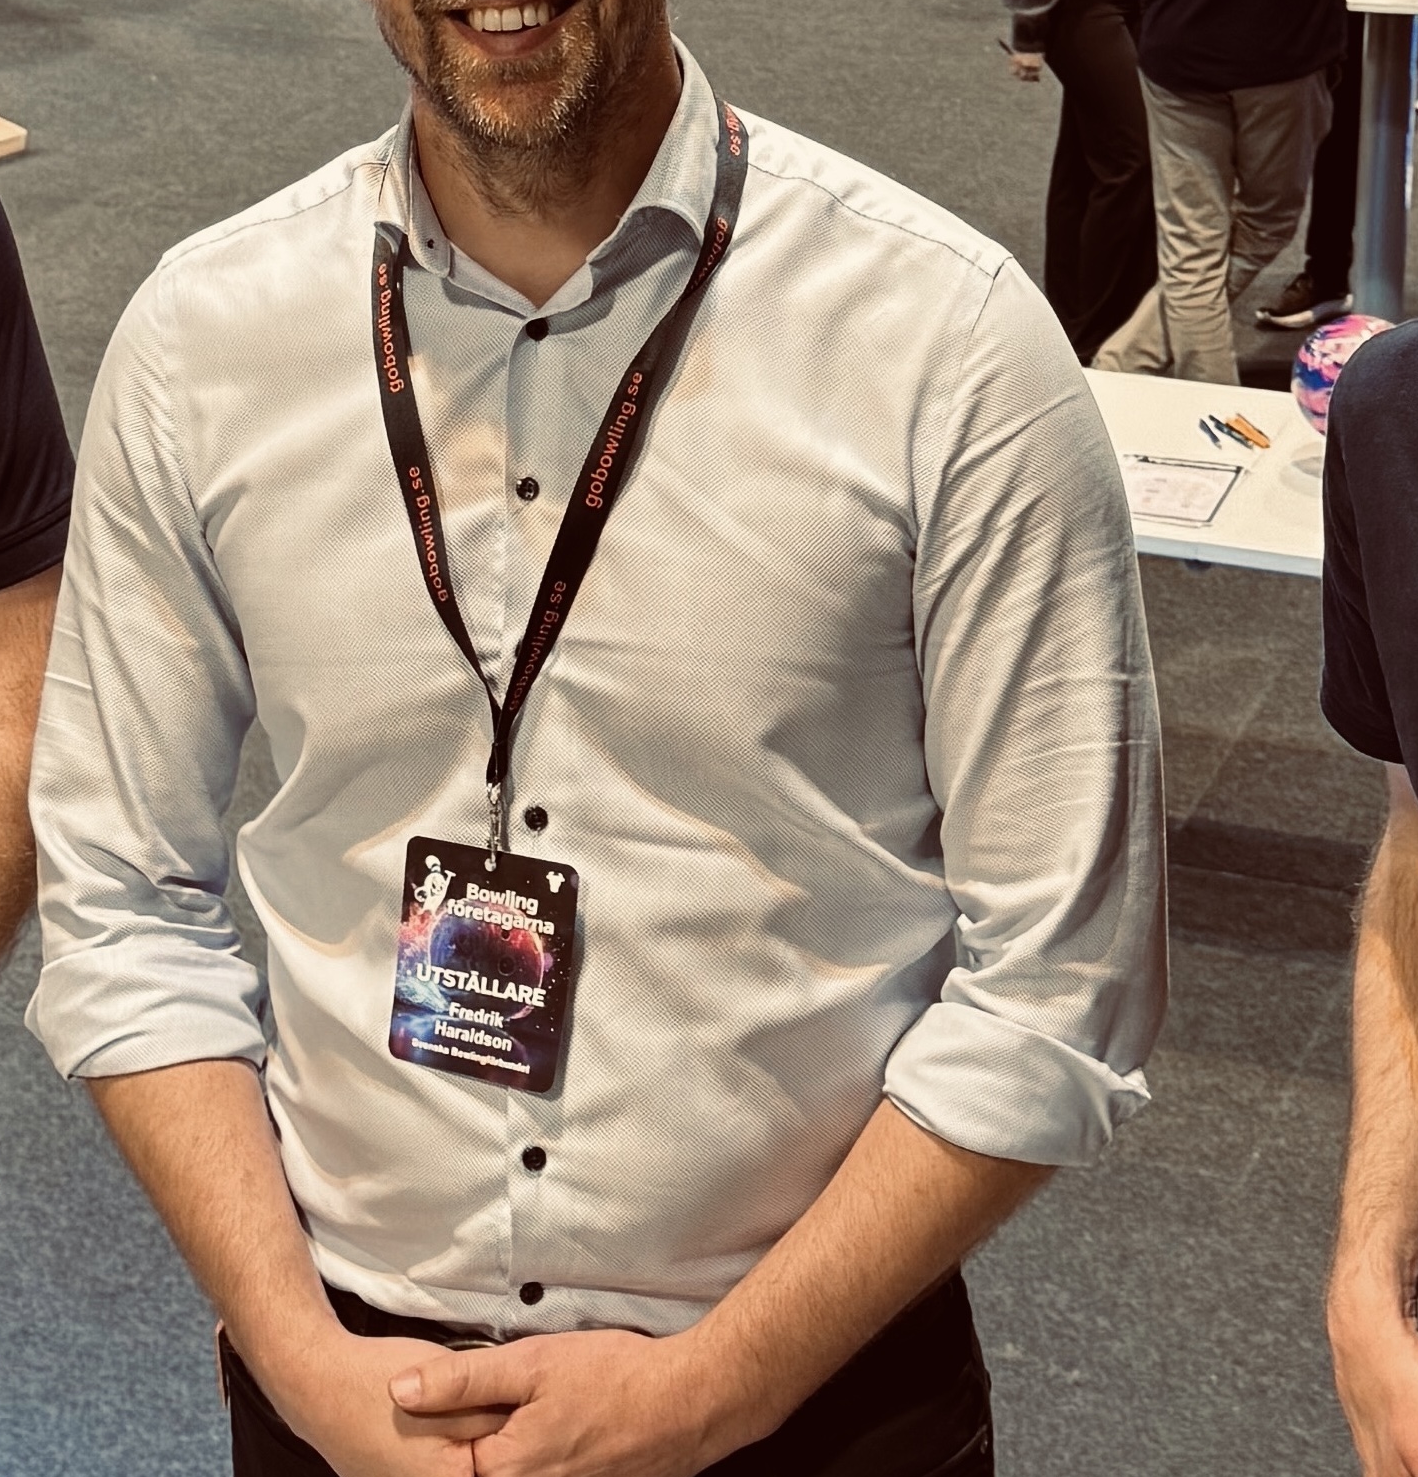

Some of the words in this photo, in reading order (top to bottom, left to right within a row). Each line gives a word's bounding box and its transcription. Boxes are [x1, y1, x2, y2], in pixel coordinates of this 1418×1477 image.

[378, 262, 405, 393] gobowling.se
[584, 371, 643, 509] gobowling.se
[408, 465, 450, 603] gobowling.se
[508, 579, 567, 712] gobowling.se
[445, 898, 556, 936] företagarna
[465, 882, 539, 916] Bowling
[416, 963, 547, 1008] UTSTÄLLARE
[434, 1019, 513, 1052] Haraldson
[448, 1001, 505, 1029] Fredrik
